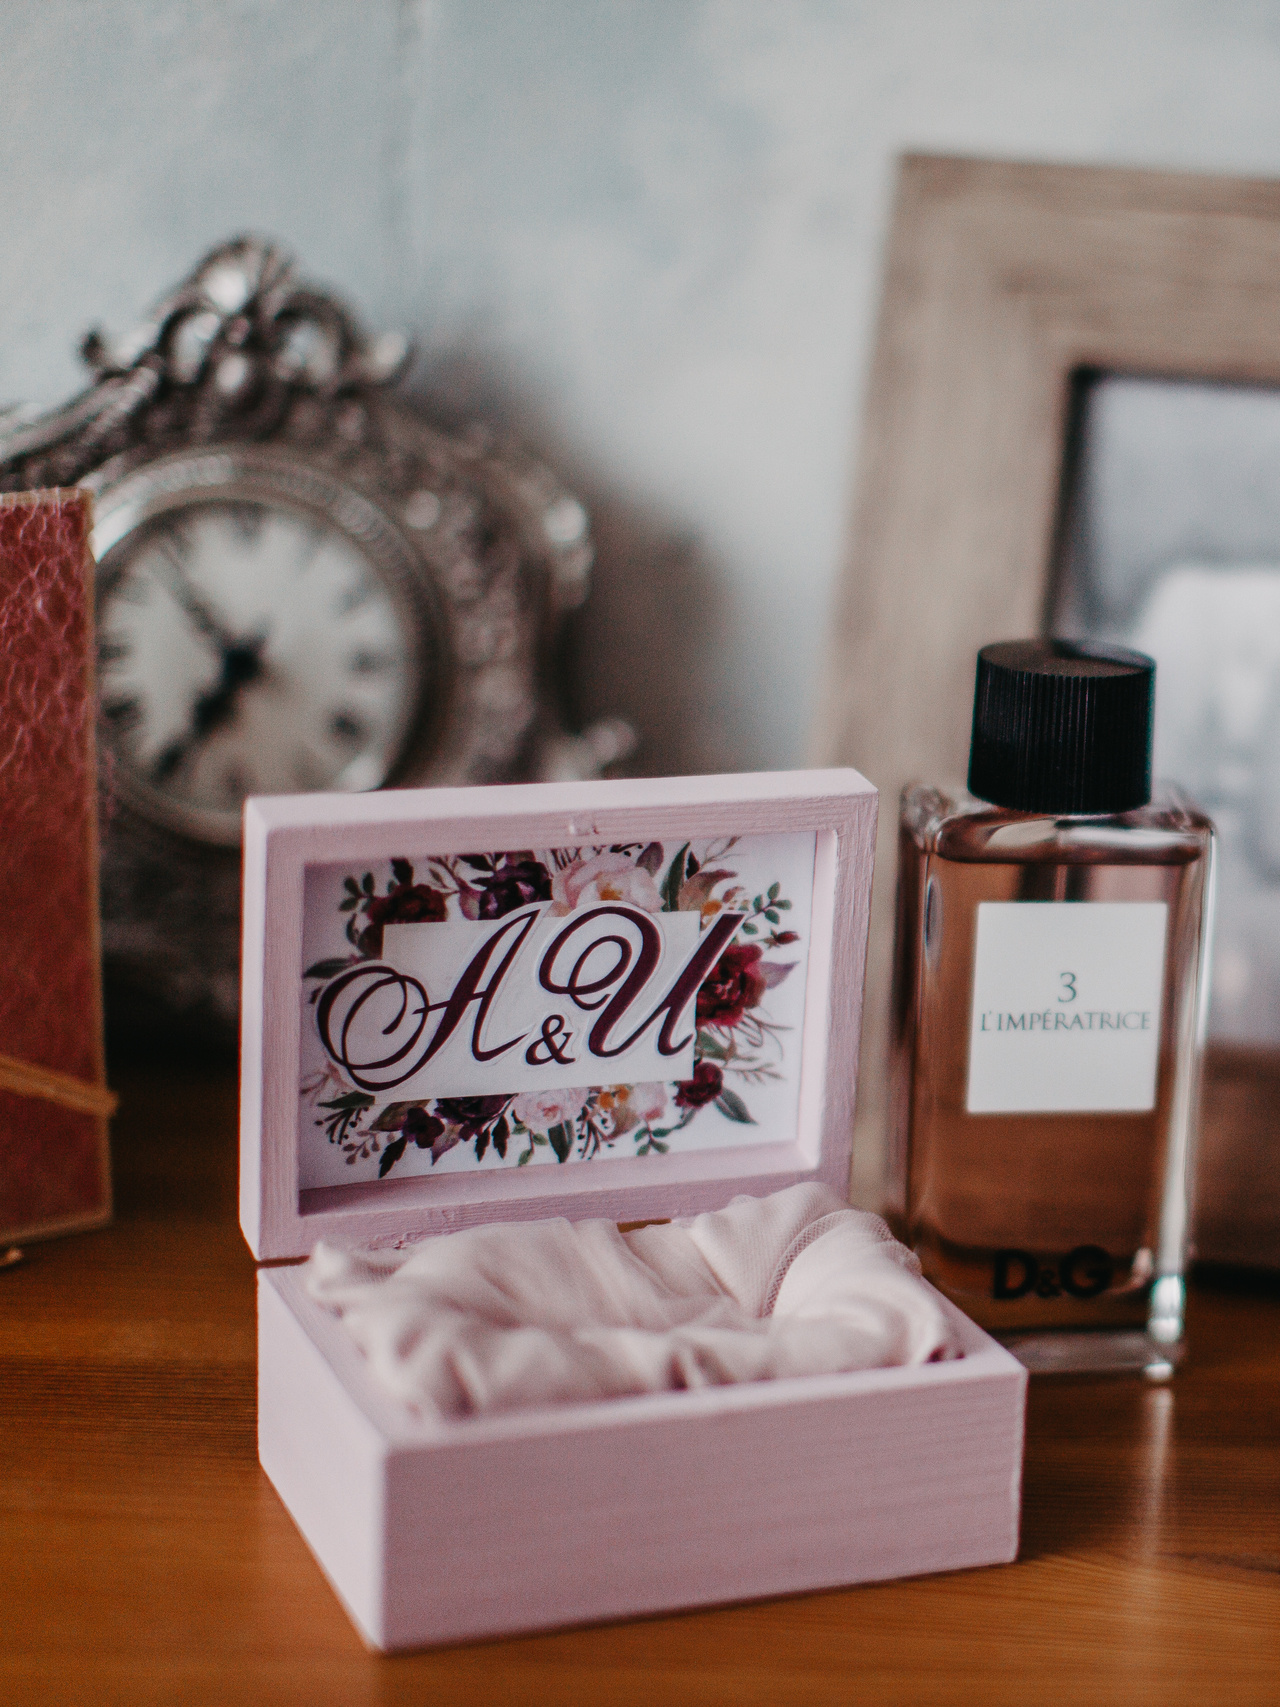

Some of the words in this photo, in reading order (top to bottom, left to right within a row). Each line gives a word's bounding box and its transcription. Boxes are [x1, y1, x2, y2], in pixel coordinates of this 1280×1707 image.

[1058, 972, 1078, 1003] 3
[980, 1009, 1151, 1031] L'IMPÉRATRICE
[994, 1245, 1114, 1299] D&G
